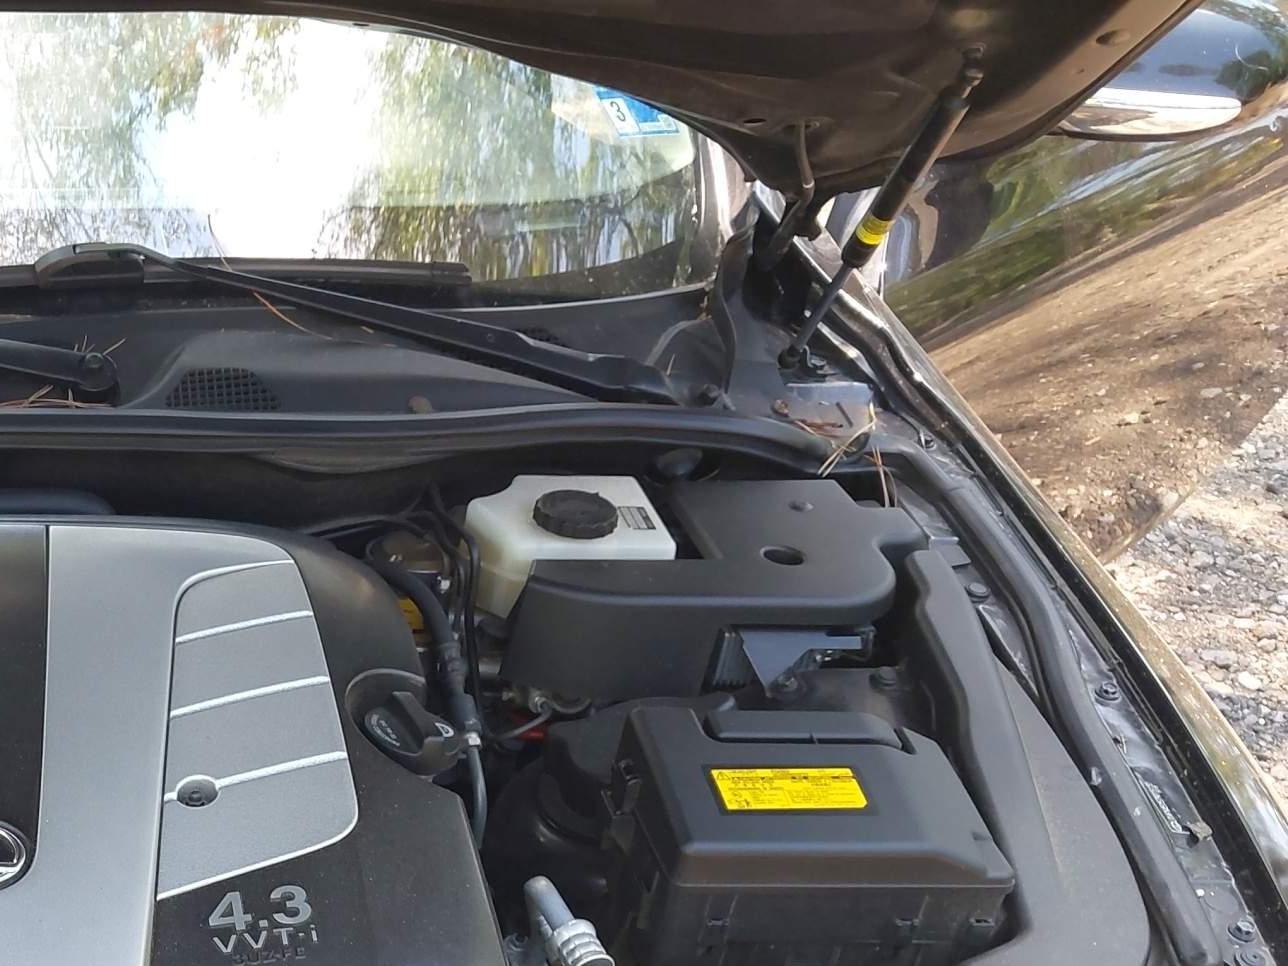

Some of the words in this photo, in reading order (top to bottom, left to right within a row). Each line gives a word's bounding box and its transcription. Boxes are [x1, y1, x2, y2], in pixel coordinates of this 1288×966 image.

[609, 100, 627, 122] 3
[208, 884, 312, 931] 4.3
[212, 924, 318, 953] VVT-i
